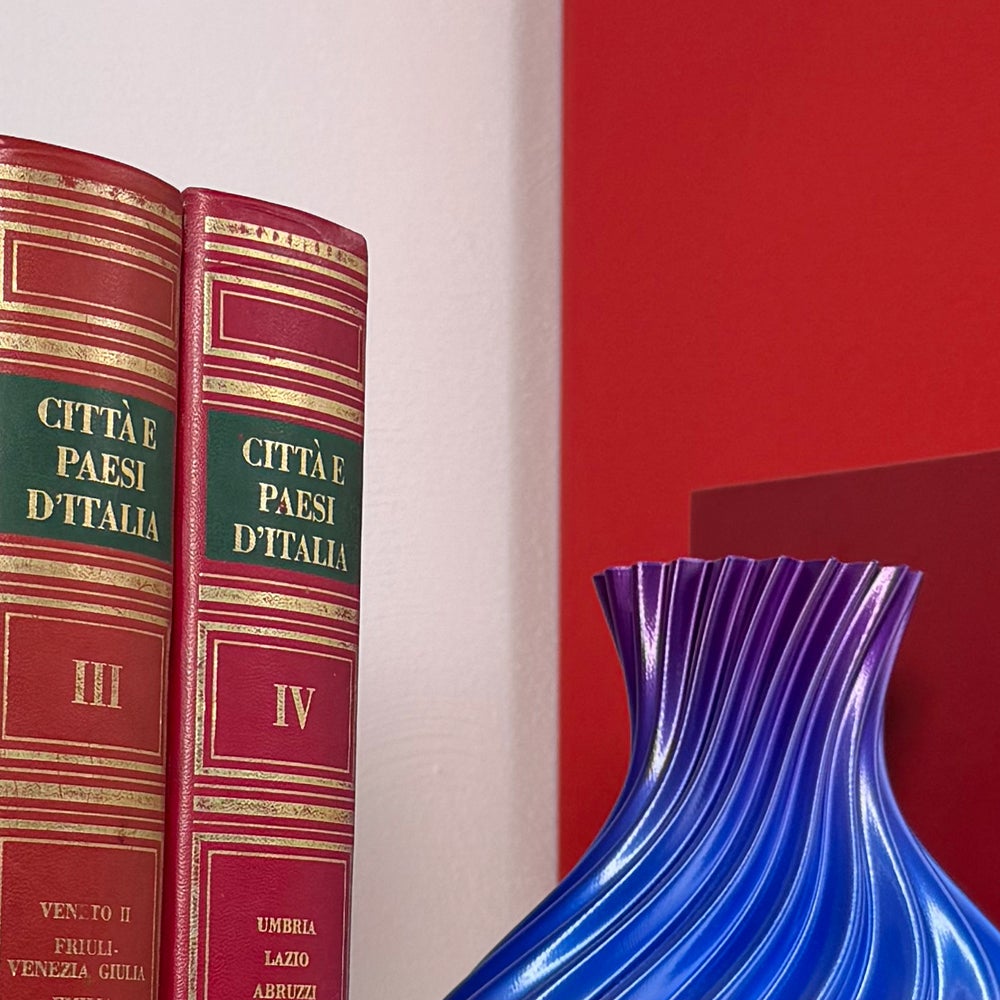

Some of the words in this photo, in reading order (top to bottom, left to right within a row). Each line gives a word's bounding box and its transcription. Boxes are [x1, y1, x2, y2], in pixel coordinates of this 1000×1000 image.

[37, 397, 137, 444] CITTÀ
[142, 417, 156, 449] E
[57, 445, 146, 491] PAESI
[242, 436, 325, 479] CITTÀ
[332, 455, 345, 486] E
[26, 489, 159, 542] D'ITALIA
[259, 482, 336, 525] PAESI
[233, 523, 348, 572] D'ITALIA
[72, 659, 122, 709] III
[273, 684, 315, 729] IV
[40, 901, 112, 923] VENTO
[121, 907, 131, 923] II
[257, 917, 317, 935] UMBRIA
[54, 938, 119, 956] FRIULI-
[264, 951, 310, 968] LAZIO
[7, 959, 89, 980] VENEZIA
[99, 965, 145, 981] GIULIA
[253, 984, 317, 1000] ABRUZZI
